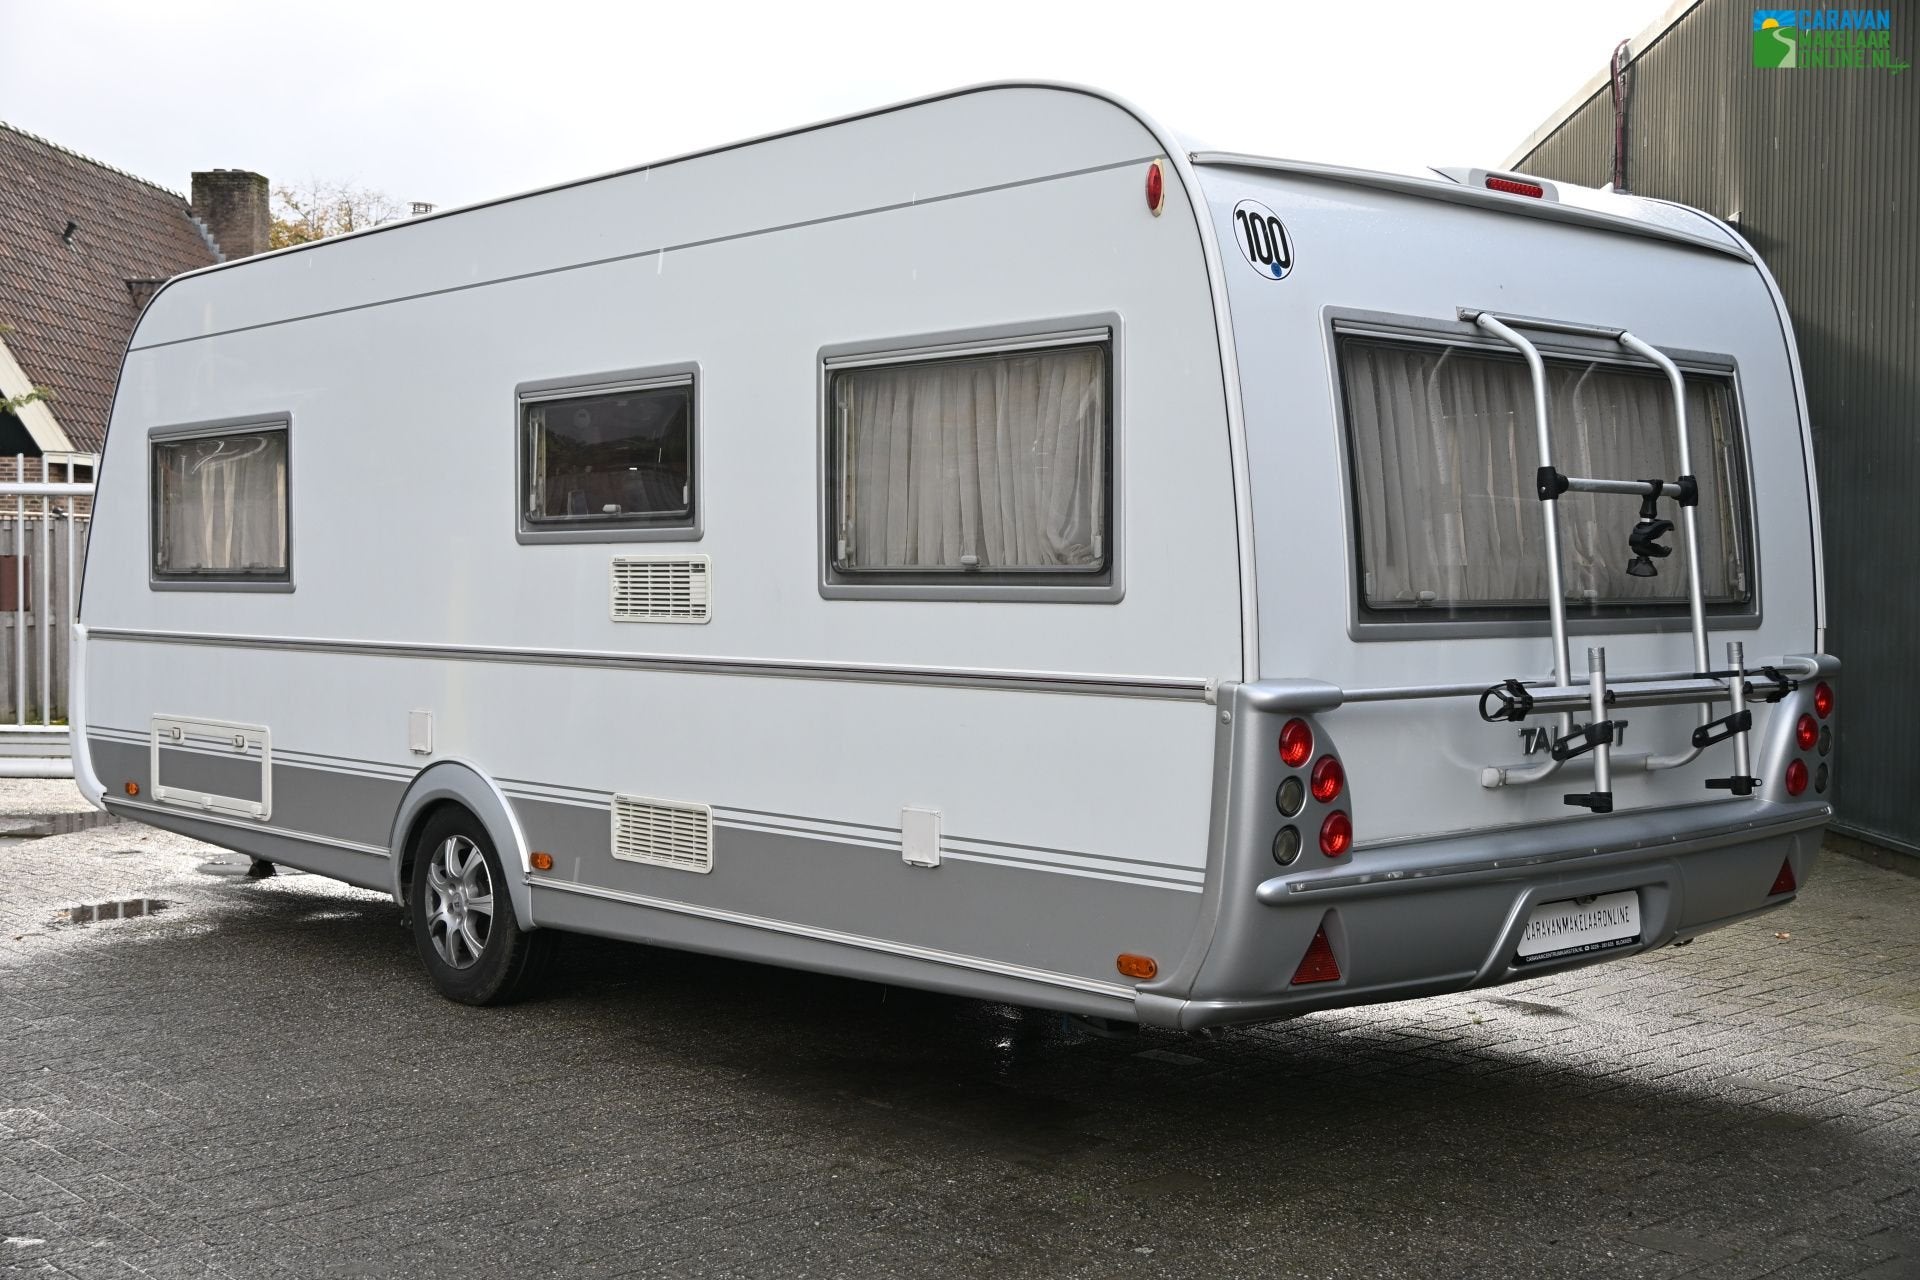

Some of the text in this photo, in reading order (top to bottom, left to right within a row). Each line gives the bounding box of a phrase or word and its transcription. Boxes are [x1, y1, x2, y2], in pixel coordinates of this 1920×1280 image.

[1236, 209, 1291, 269] 100
[1518, 720, 1628, 755] TALT
[1526, 906, 1629, 940] CARAVANMAKELAARONLINE
